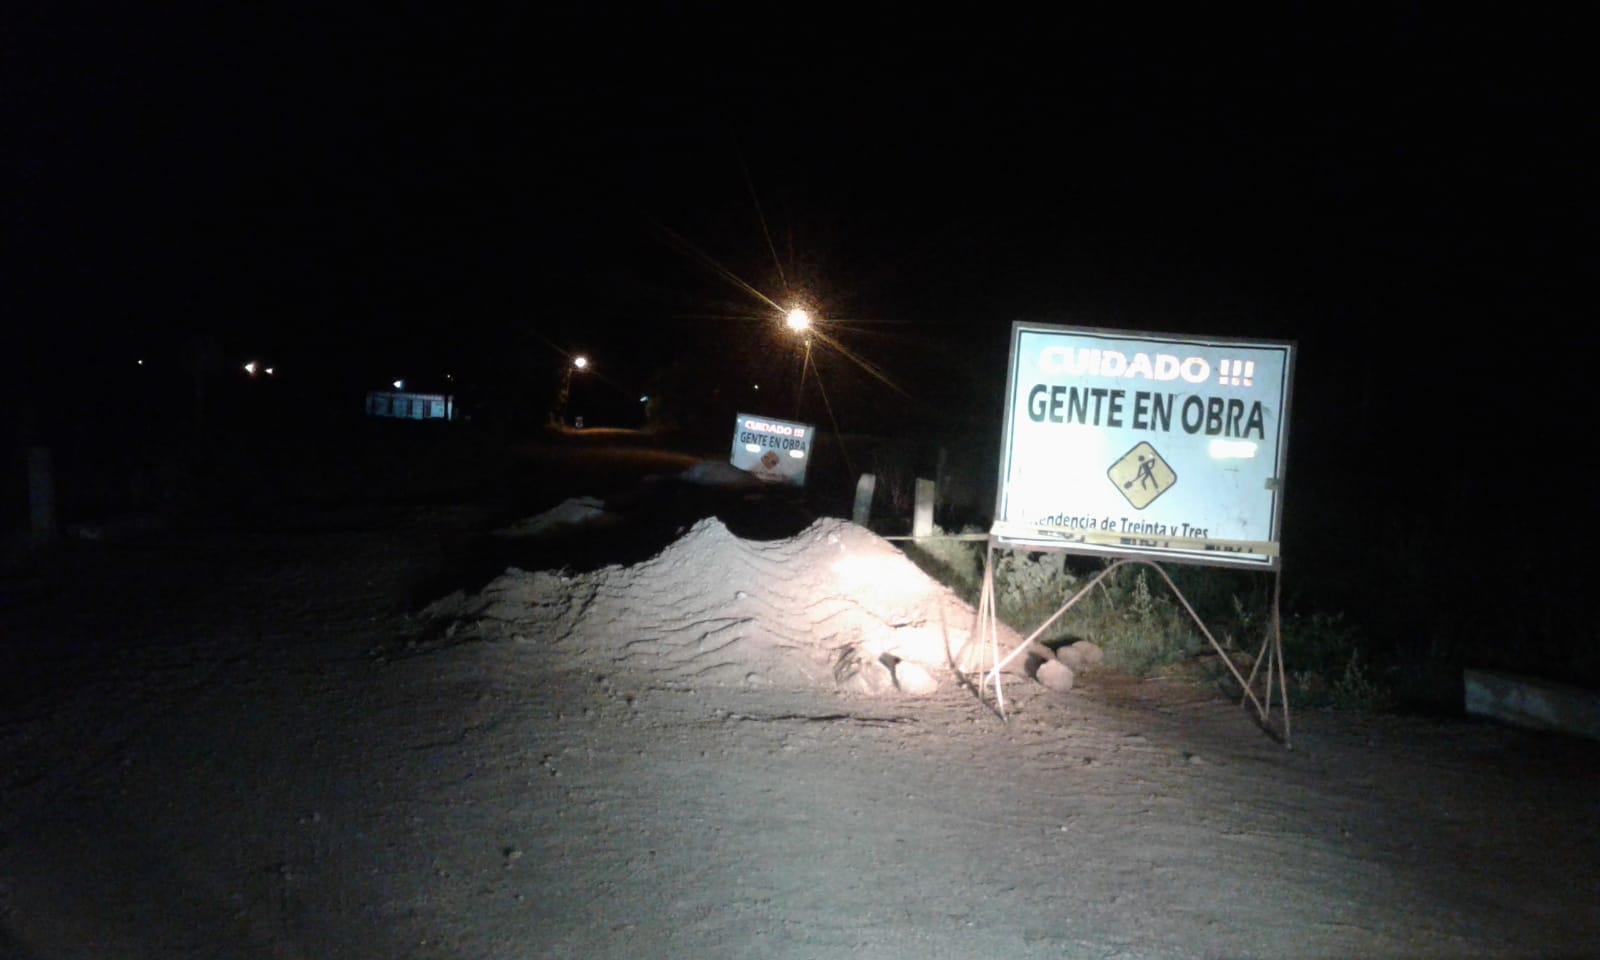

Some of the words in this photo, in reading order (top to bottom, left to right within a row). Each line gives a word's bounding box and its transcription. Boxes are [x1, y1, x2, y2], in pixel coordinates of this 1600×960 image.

[1038, 346, 1210, 383] CUIDADO
[1218, 358, 1255, 387] !!!
[1028, 384, 1125, 428] GENTE
[1132, 391, 1174, 432] EN
[1181, 395, 1265, 440] OBRA
[744, 420, 792, 435] CUIDADO
[740, 431, 768, 446] GENTE
[769, 436, 782, 449] EN
[782, 438, 806, 451] OBRA
[1100, 517, 1117, 531] de
[1120, 517, 1167, 535] Treinta
[1181, 523, 1209, 539] Tres
